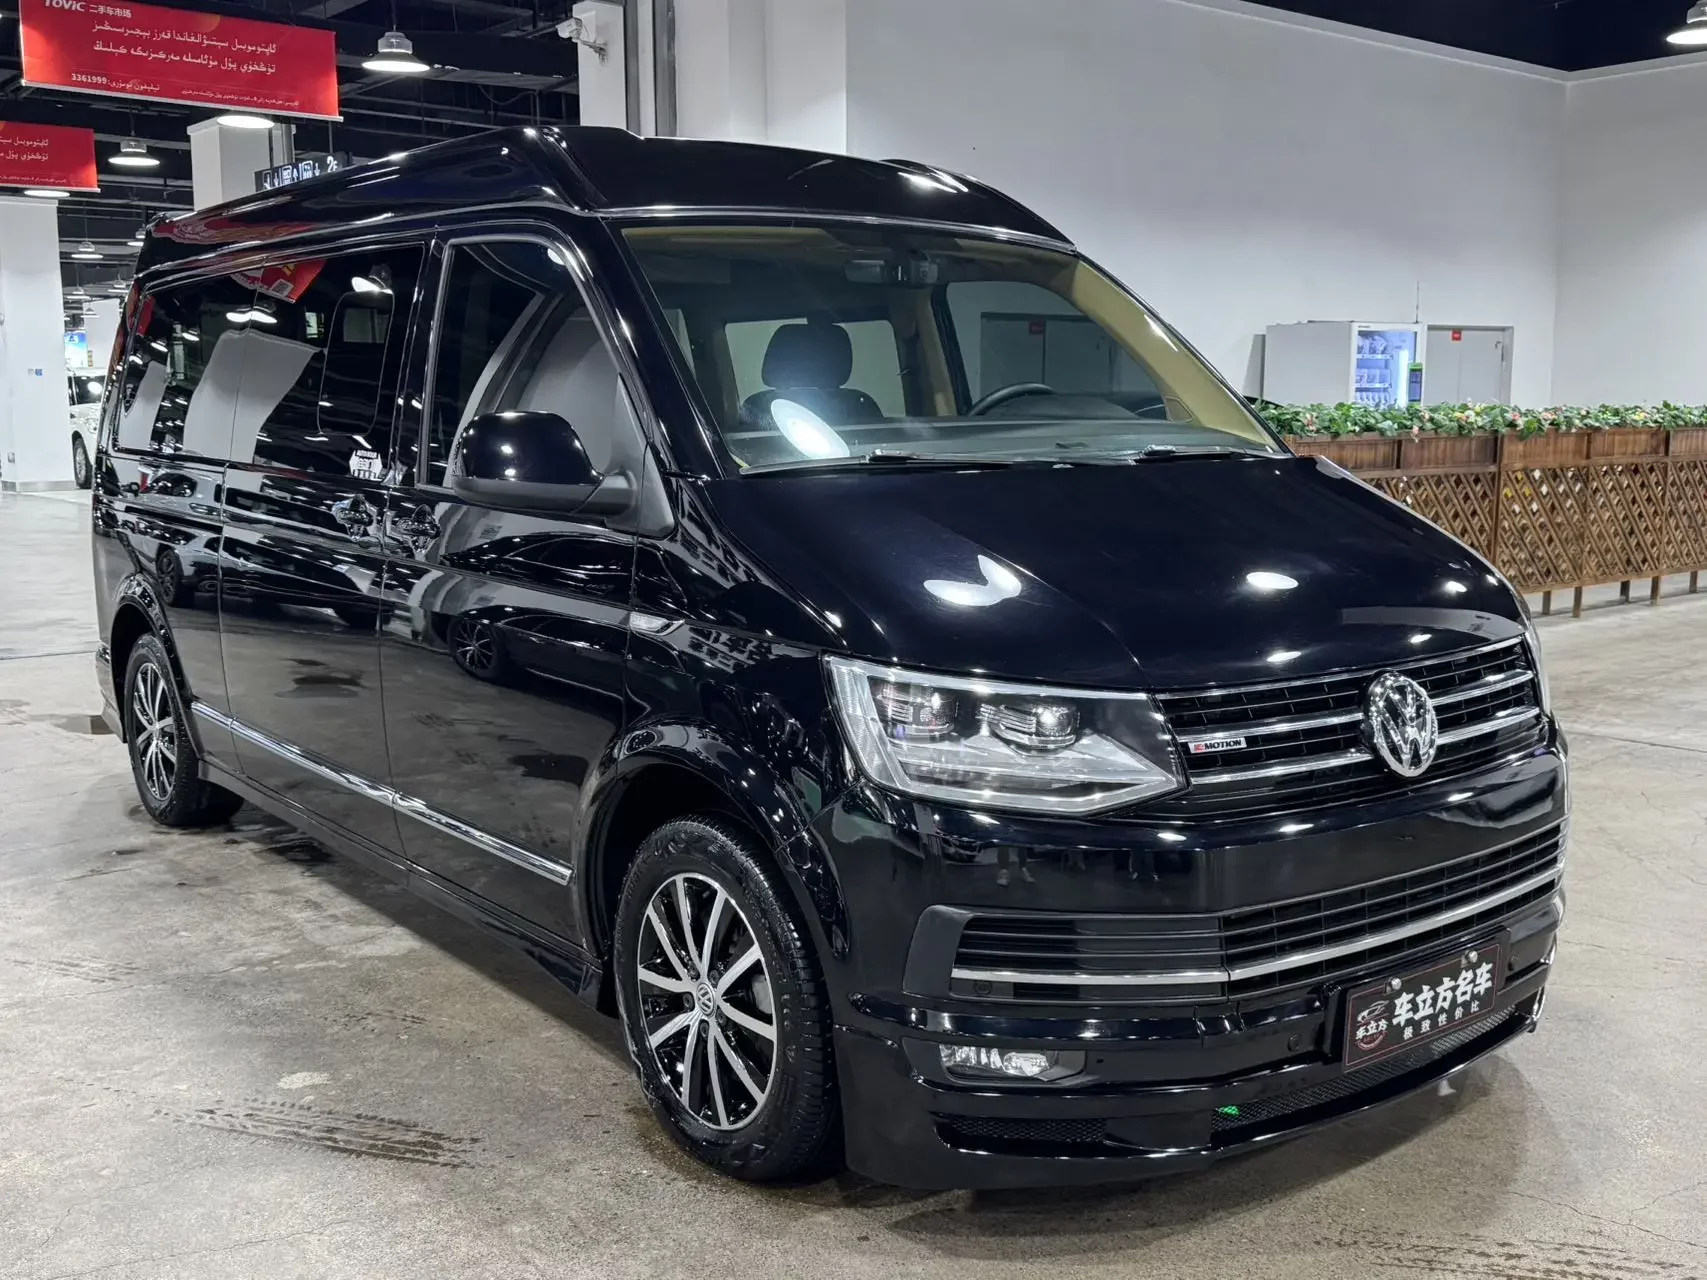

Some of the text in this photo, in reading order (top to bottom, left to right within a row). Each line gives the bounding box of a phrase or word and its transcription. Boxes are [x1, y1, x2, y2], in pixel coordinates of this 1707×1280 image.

[89, 4, 132, 18] 二手车市场
[327, 155, 338, 173] 2F
[1392, 962, 1493, 1027] 车立方名车
[1356, 1018, 1389, 1040] 车立方
